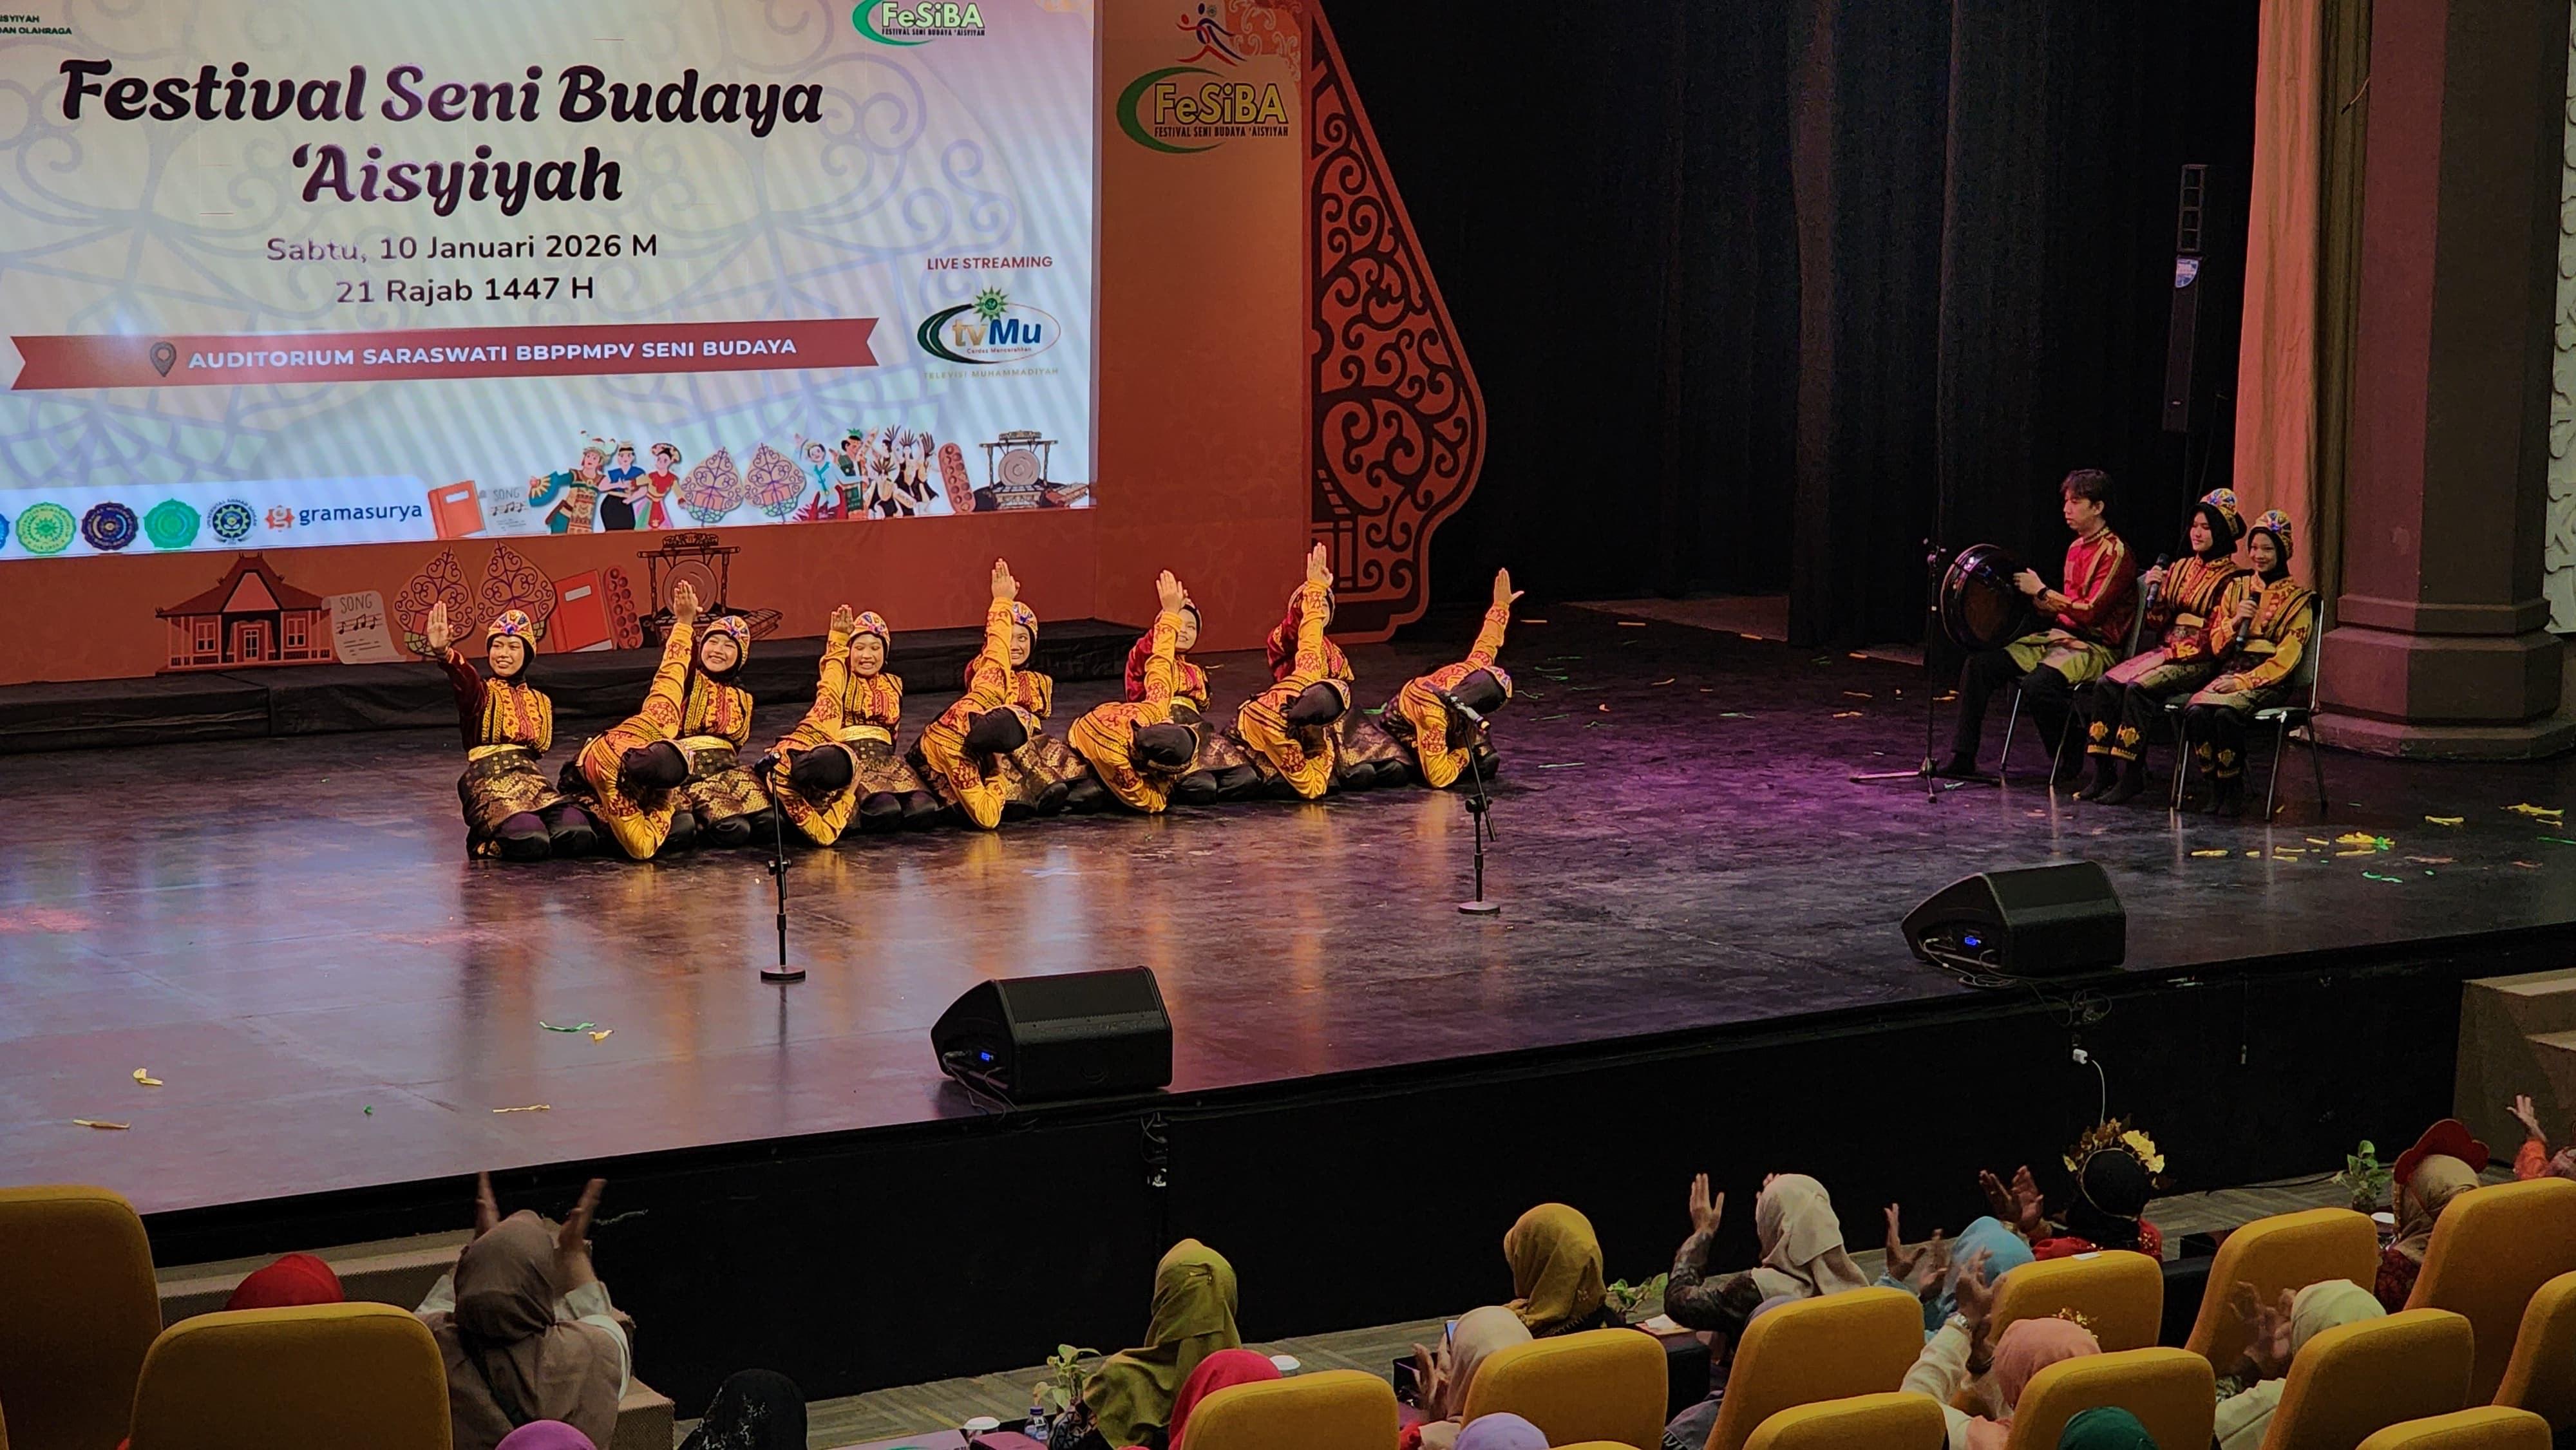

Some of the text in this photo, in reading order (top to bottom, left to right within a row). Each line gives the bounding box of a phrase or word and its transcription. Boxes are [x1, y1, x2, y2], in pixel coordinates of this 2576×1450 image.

[882, 1, 985, 28] FeSiBA
[60, 59, 823, 138] Festival Seni Budaya
[1154, 82, 1289, 124] FeSiBA
[1154, 127, 1191, 137] FESTIVAL
[1193, 127, 1211, 137] SENI
[1215, 127, 1245, 137] BUDAYA
[267, 234, 656, 263] Sabtu, 10 Januari 2026 M
[927, 256, 1053, 270] LIVE STREAMING
[336, 276, 593, 306] 21 Rajab 1447 H
[952, 319, 1041, 346] tvMu
[188, 339, 797, 369] AUDITORIUM SARASWATI BBPPMPV SENI BUDAYA
[972, 368, 1058, 377] MUHAMMADIYAH
[493, 487, 520, 502] SONG
[299, 504, 422, 526] gramasurya
[340, 593, 373, 614] SONG
